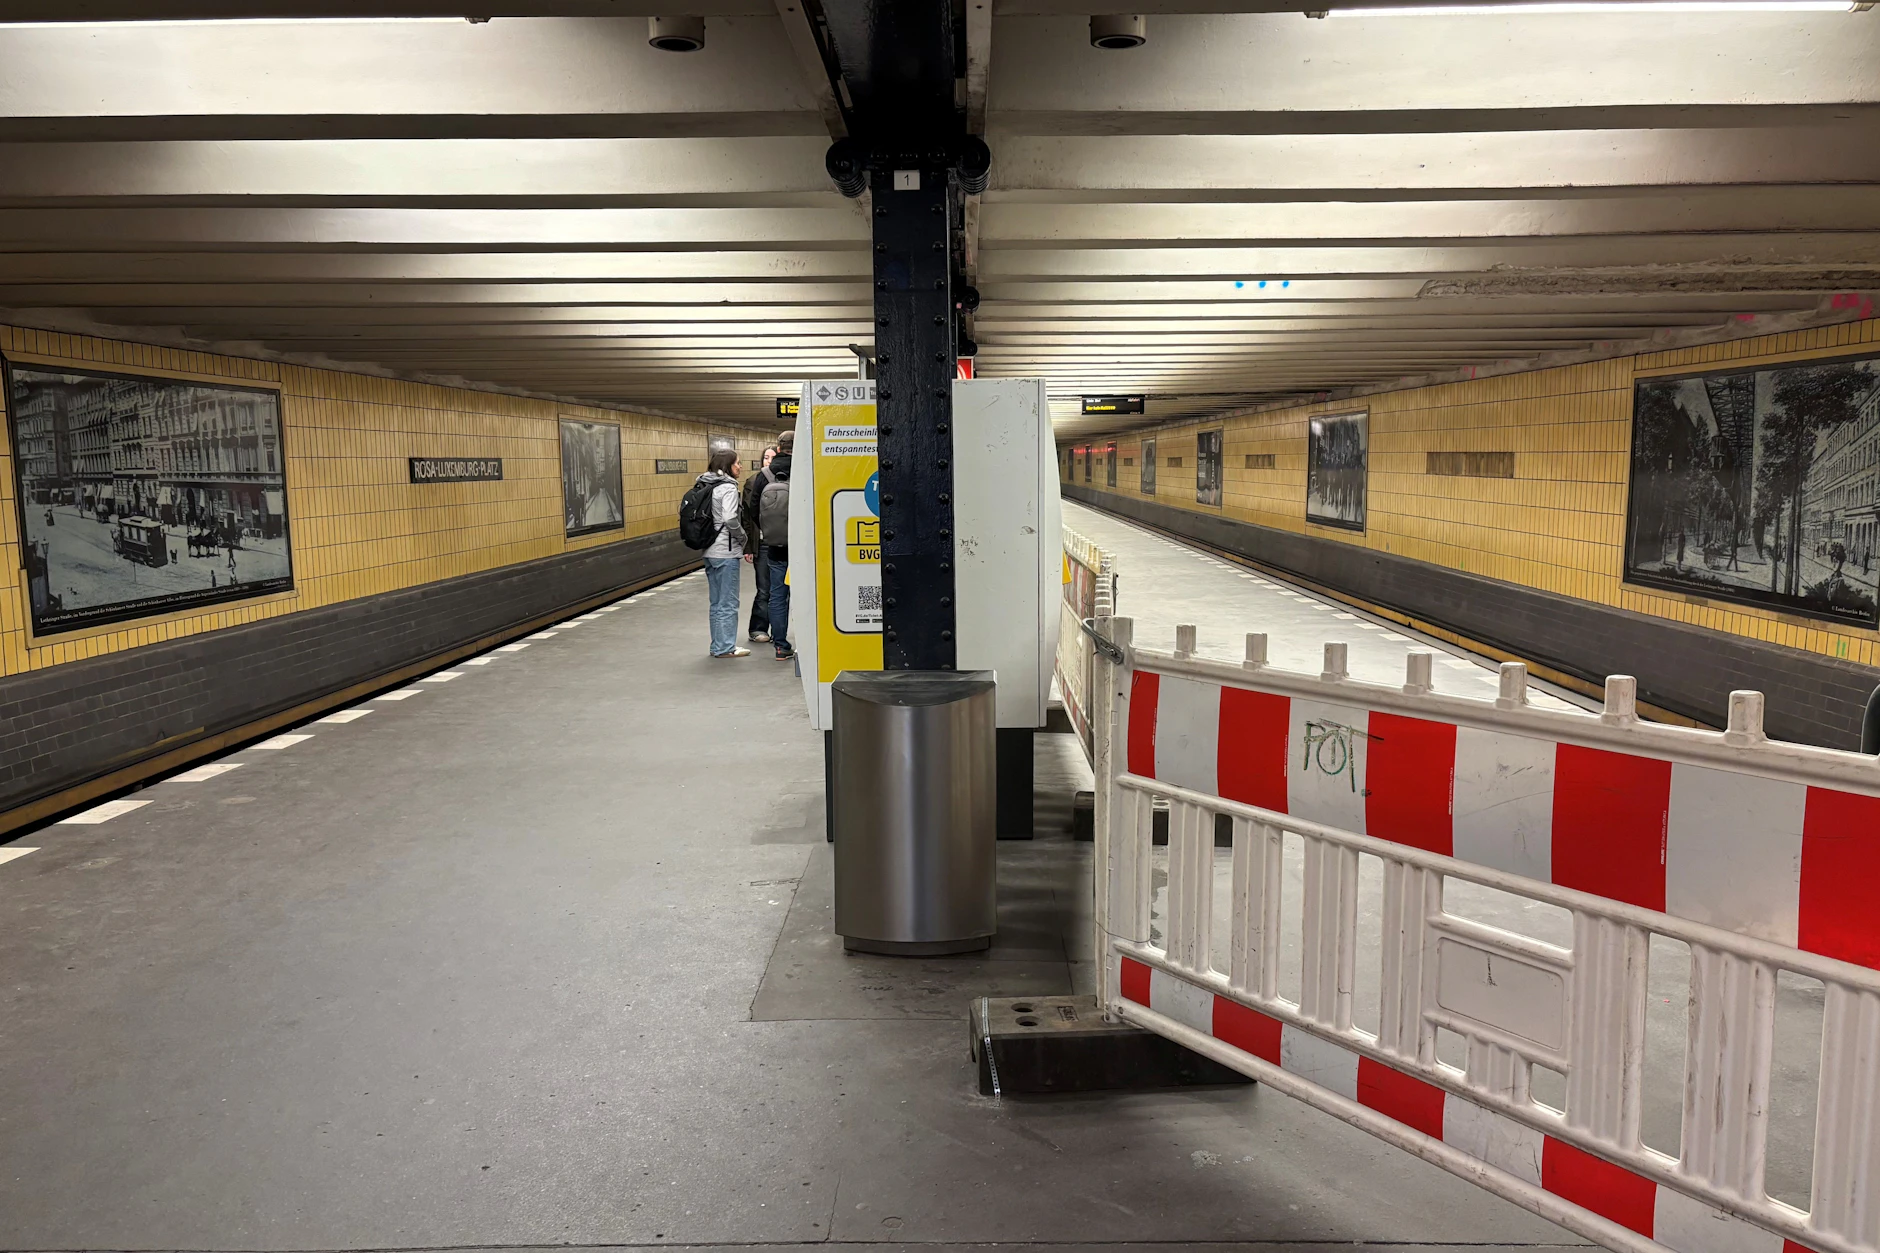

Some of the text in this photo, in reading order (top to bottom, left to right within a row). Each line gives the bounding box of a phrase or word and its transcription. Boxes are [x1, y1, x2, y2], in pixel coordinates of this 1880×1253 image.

[904, 174, 909, 186] 1
[837, 387, 847, 399] S
[854, 387, 864, 399] U
[859, 548, 880, 560] BVG
